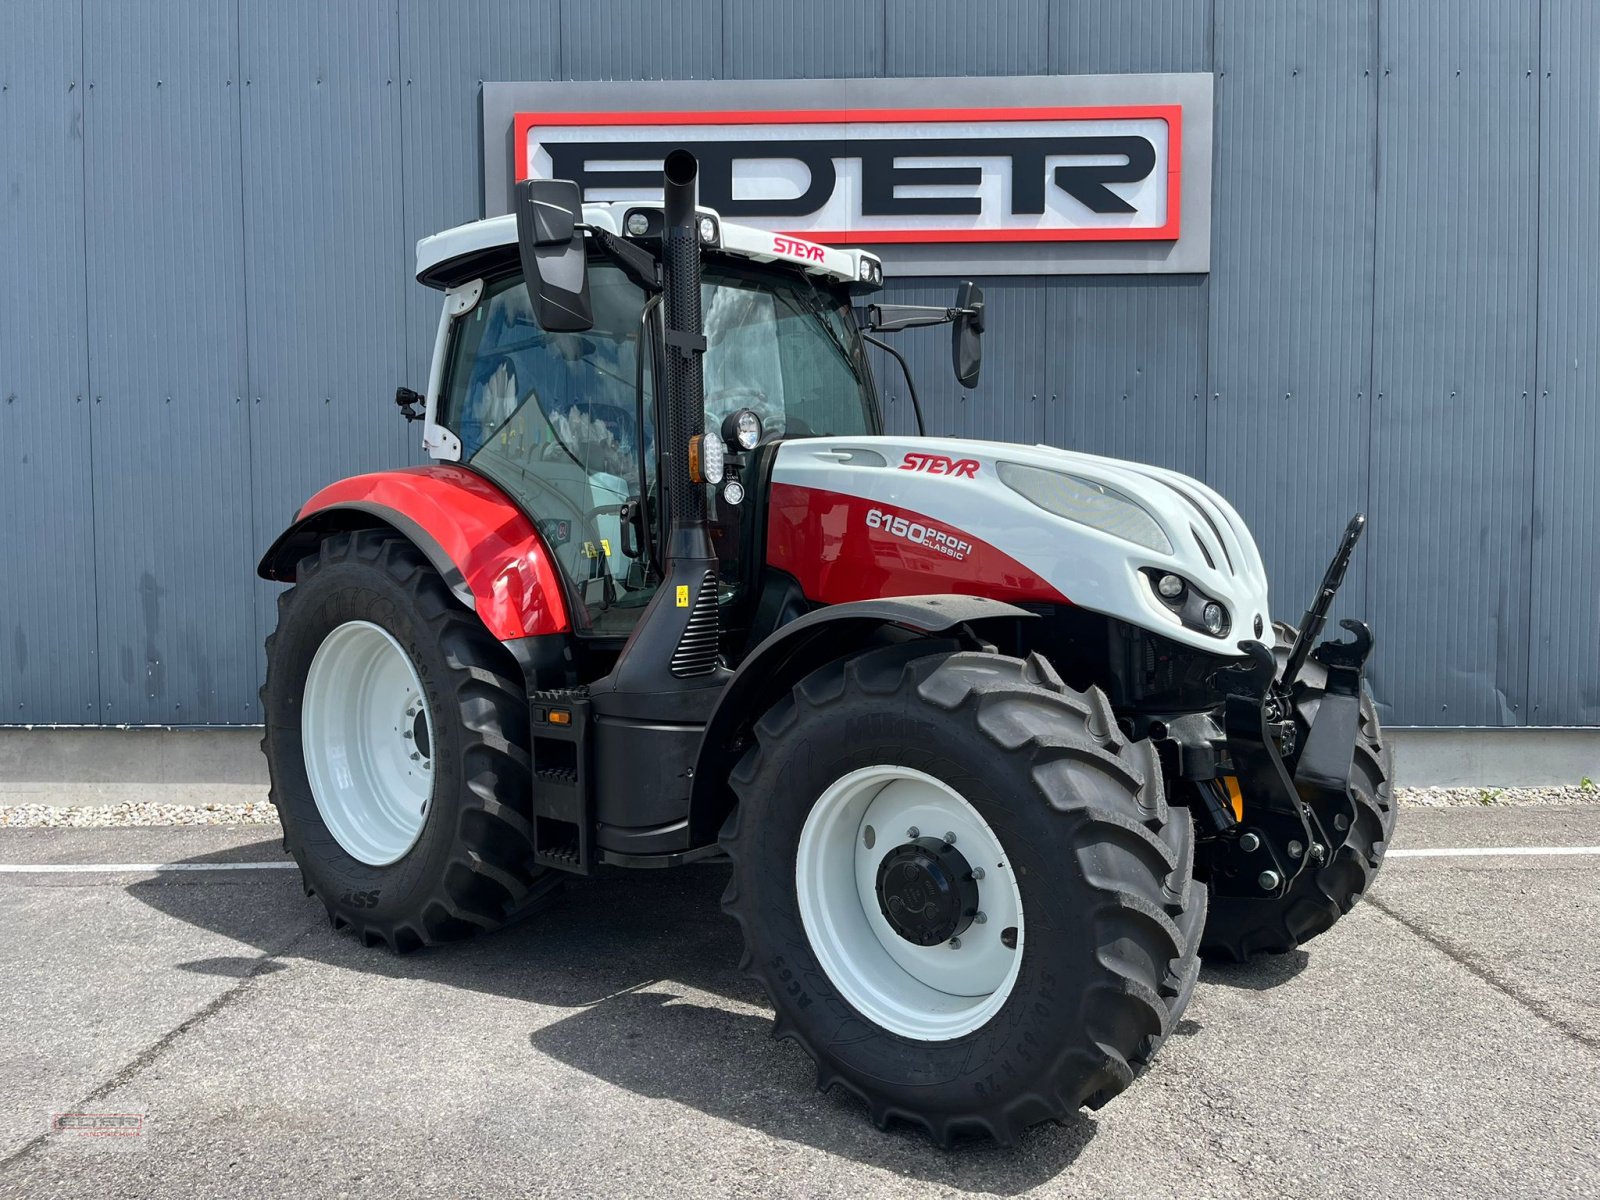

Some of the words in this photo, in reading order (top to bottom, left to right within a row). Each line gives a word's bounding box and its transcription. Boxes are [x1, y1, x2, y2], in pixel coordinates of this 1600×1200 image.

[539, 134, 1157, 217] EDER
[773, 237, 825, 263] STEYR
[898, 452, 981, 479] STEYR
[866, 508, 926, 544] 6150
[926, 527, 972, 555] PROFI
[922, 539, 964, 561] CLASSIC
